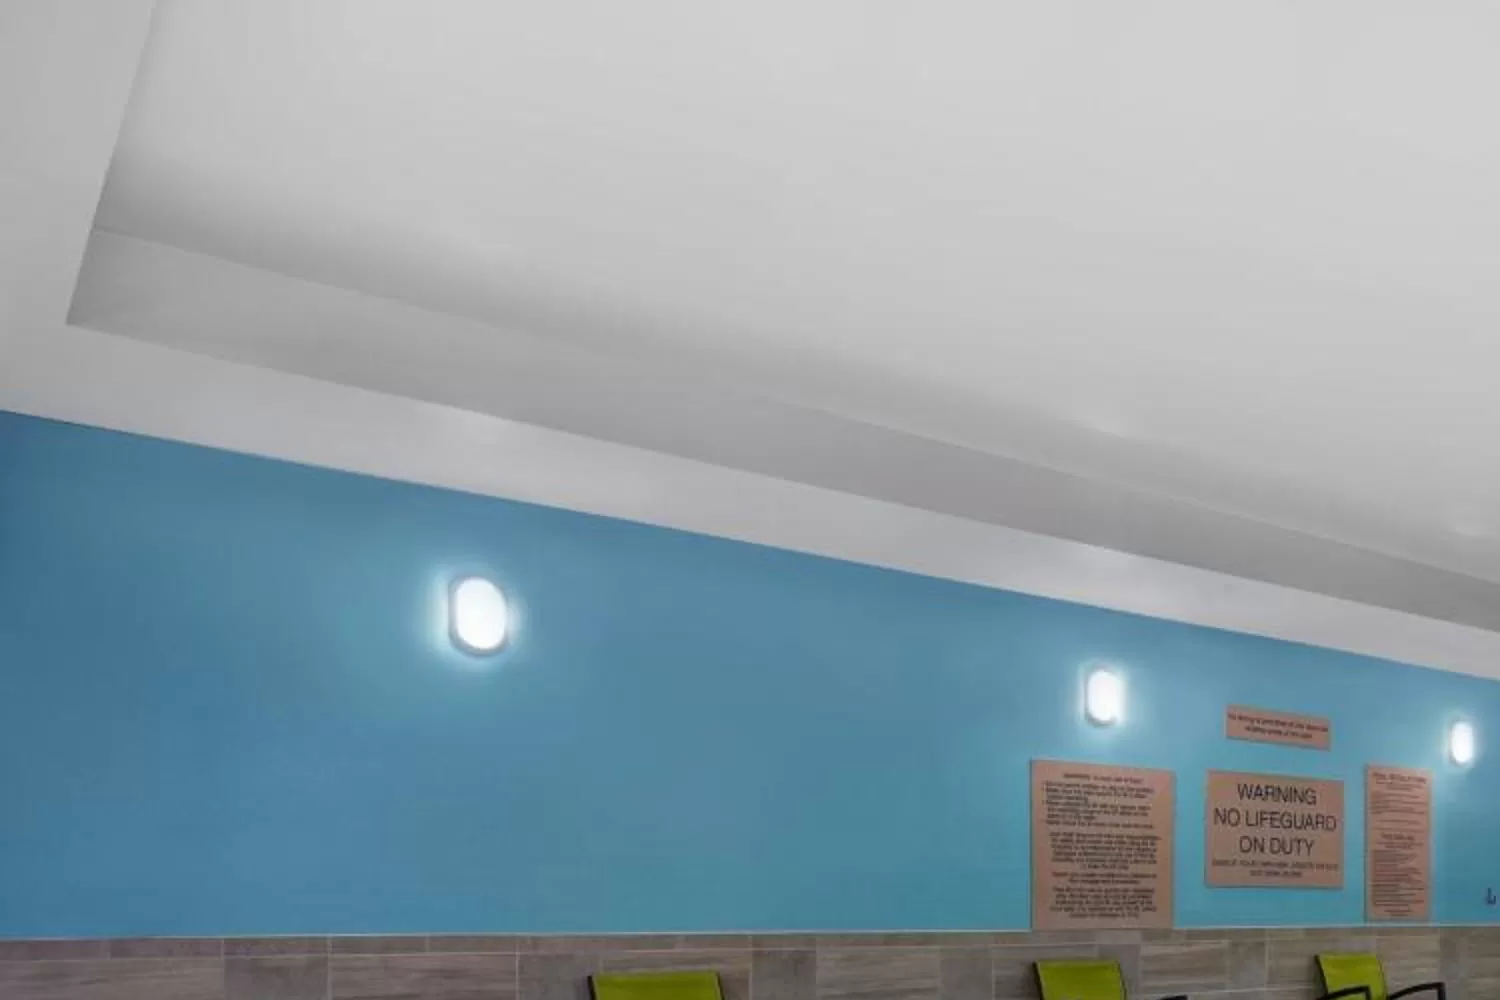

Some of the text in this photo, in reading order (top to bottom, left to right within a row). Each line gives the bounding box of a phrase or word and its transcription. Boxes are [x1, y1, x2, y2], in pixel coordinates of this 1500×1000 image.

[1237, 783, 1317, 805] WARNING
[1213, 807, 1337, 831] NO LIFEGUARD
[1239, 835, 1315, 856] ON DUTY
